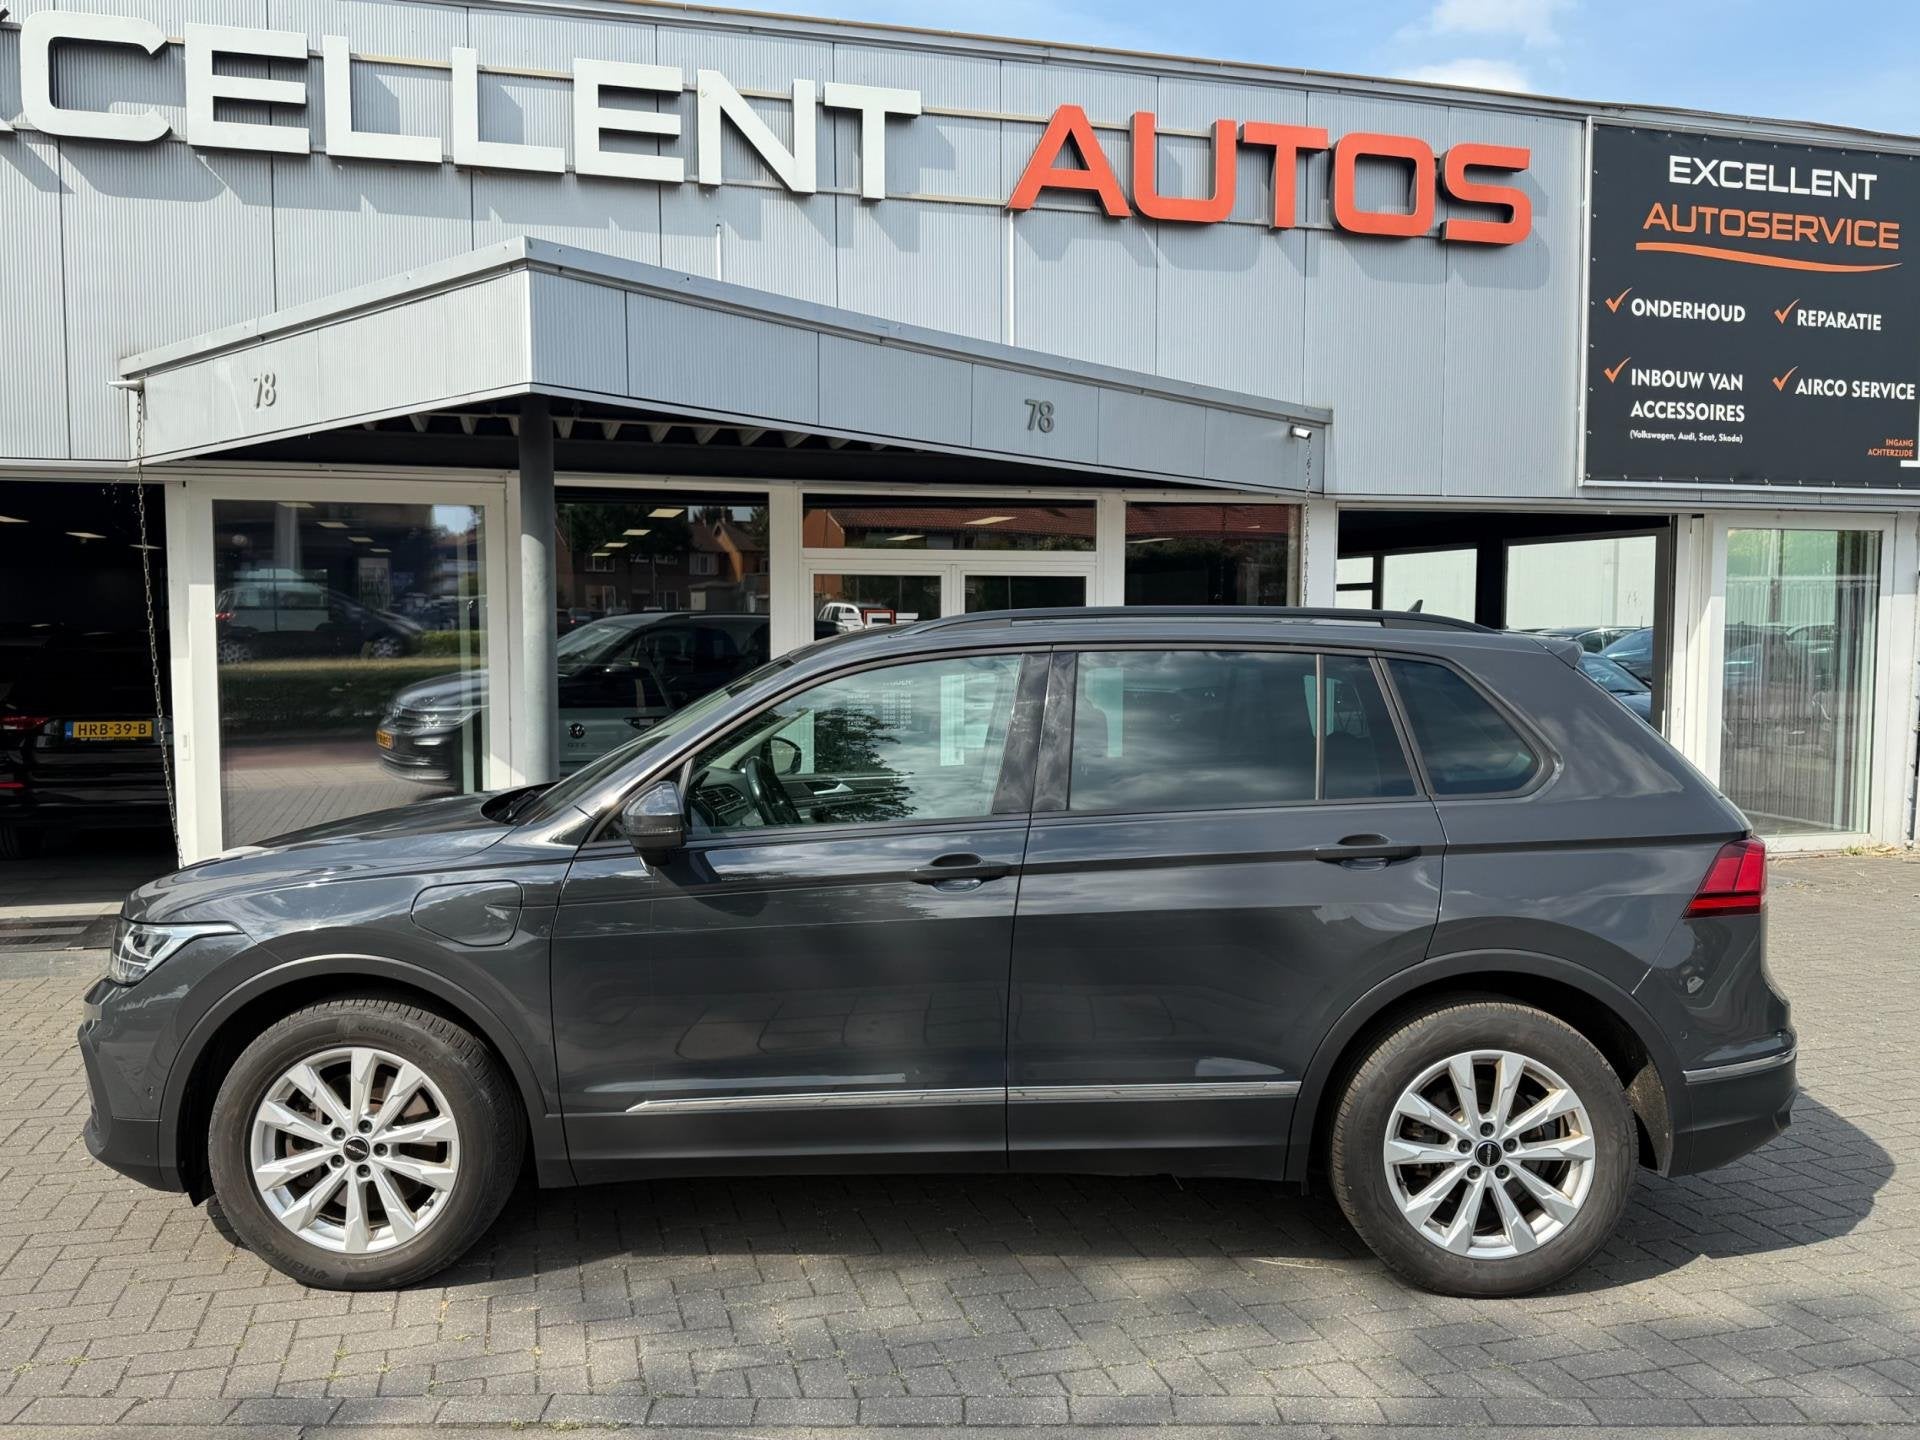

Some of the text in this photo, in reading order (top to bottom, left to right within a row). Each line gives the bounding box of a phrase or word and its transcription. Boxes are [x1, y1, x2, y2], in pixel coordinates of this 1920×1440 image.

[0, 10, 1532, 245] CELLENT AUTOS
[1669, 155, 1878, 200] EXCELLENT
[1643, 203, 1900, 250] AUTOSERVICE
[1631, 298, 1746, 322] ONDERHOUD
[1797, 309, 1882, 331] REPARATIE
[252, 371, 276, 409] 78
[1631, 368, 1743, 391] INBOUW VAN
[1795, 378, 1916, 400] AIRCO SERVICE
[1024, 398, 1054, 433] 78
[1630, 400, 1745, 422] ACCESSOIRES
[1630, 429, 1676, 441] (Volkswagen,
[1678, 432, 1697, 442] Audi,
[1885, 439, 1914, 447] INGANG
[78, 723, 147, 736] HRB-39-B
